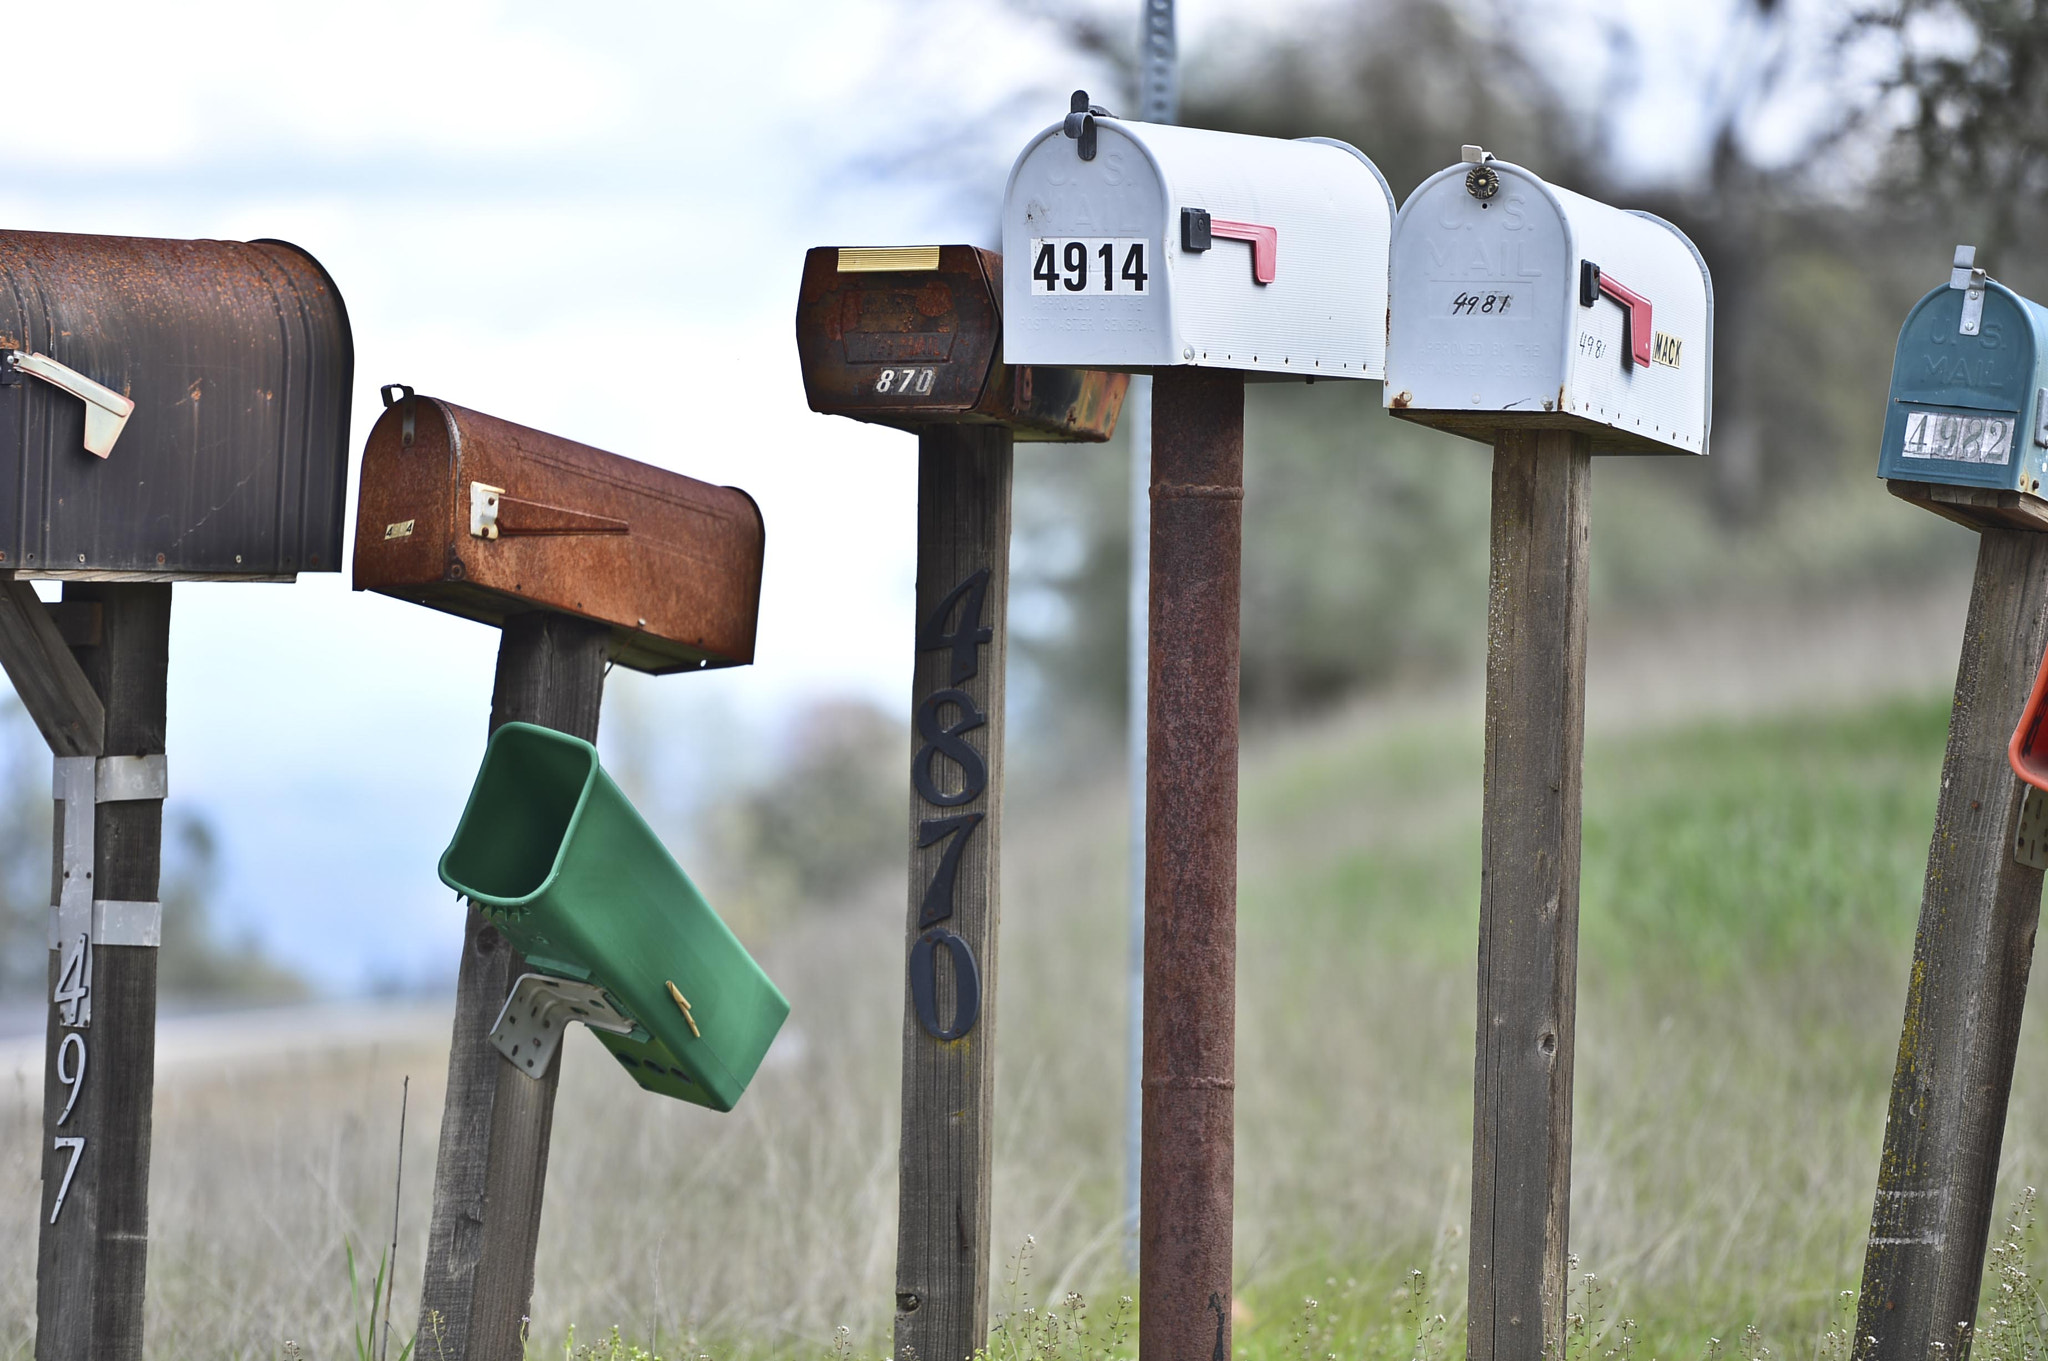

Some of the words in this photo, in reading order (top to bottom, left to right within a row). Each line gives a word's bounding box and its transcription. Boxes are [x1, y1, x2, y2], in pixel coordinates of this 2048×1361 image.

[1438, 195, 1473, 231] U.
[1501, 192, 1535, 232] S.
[1033, 241, 1148, 292] 4914
[1423, 237, 1543, 278] MAIL
[1452, 291, 1511, 315] 4981
[1579, 331, 1607, 359] 4981
[1654, 332, 1682, 367] MACK
[1978, 322, 2007, 350] S.
[875, 369, 934, 393] 870
[1919, 353, 2005, 389] MAIL
[1907, 415, 2008, 463] 4982
[909, 567, 994, 1041] 4870
[50, 933, 89, 1224] 497
